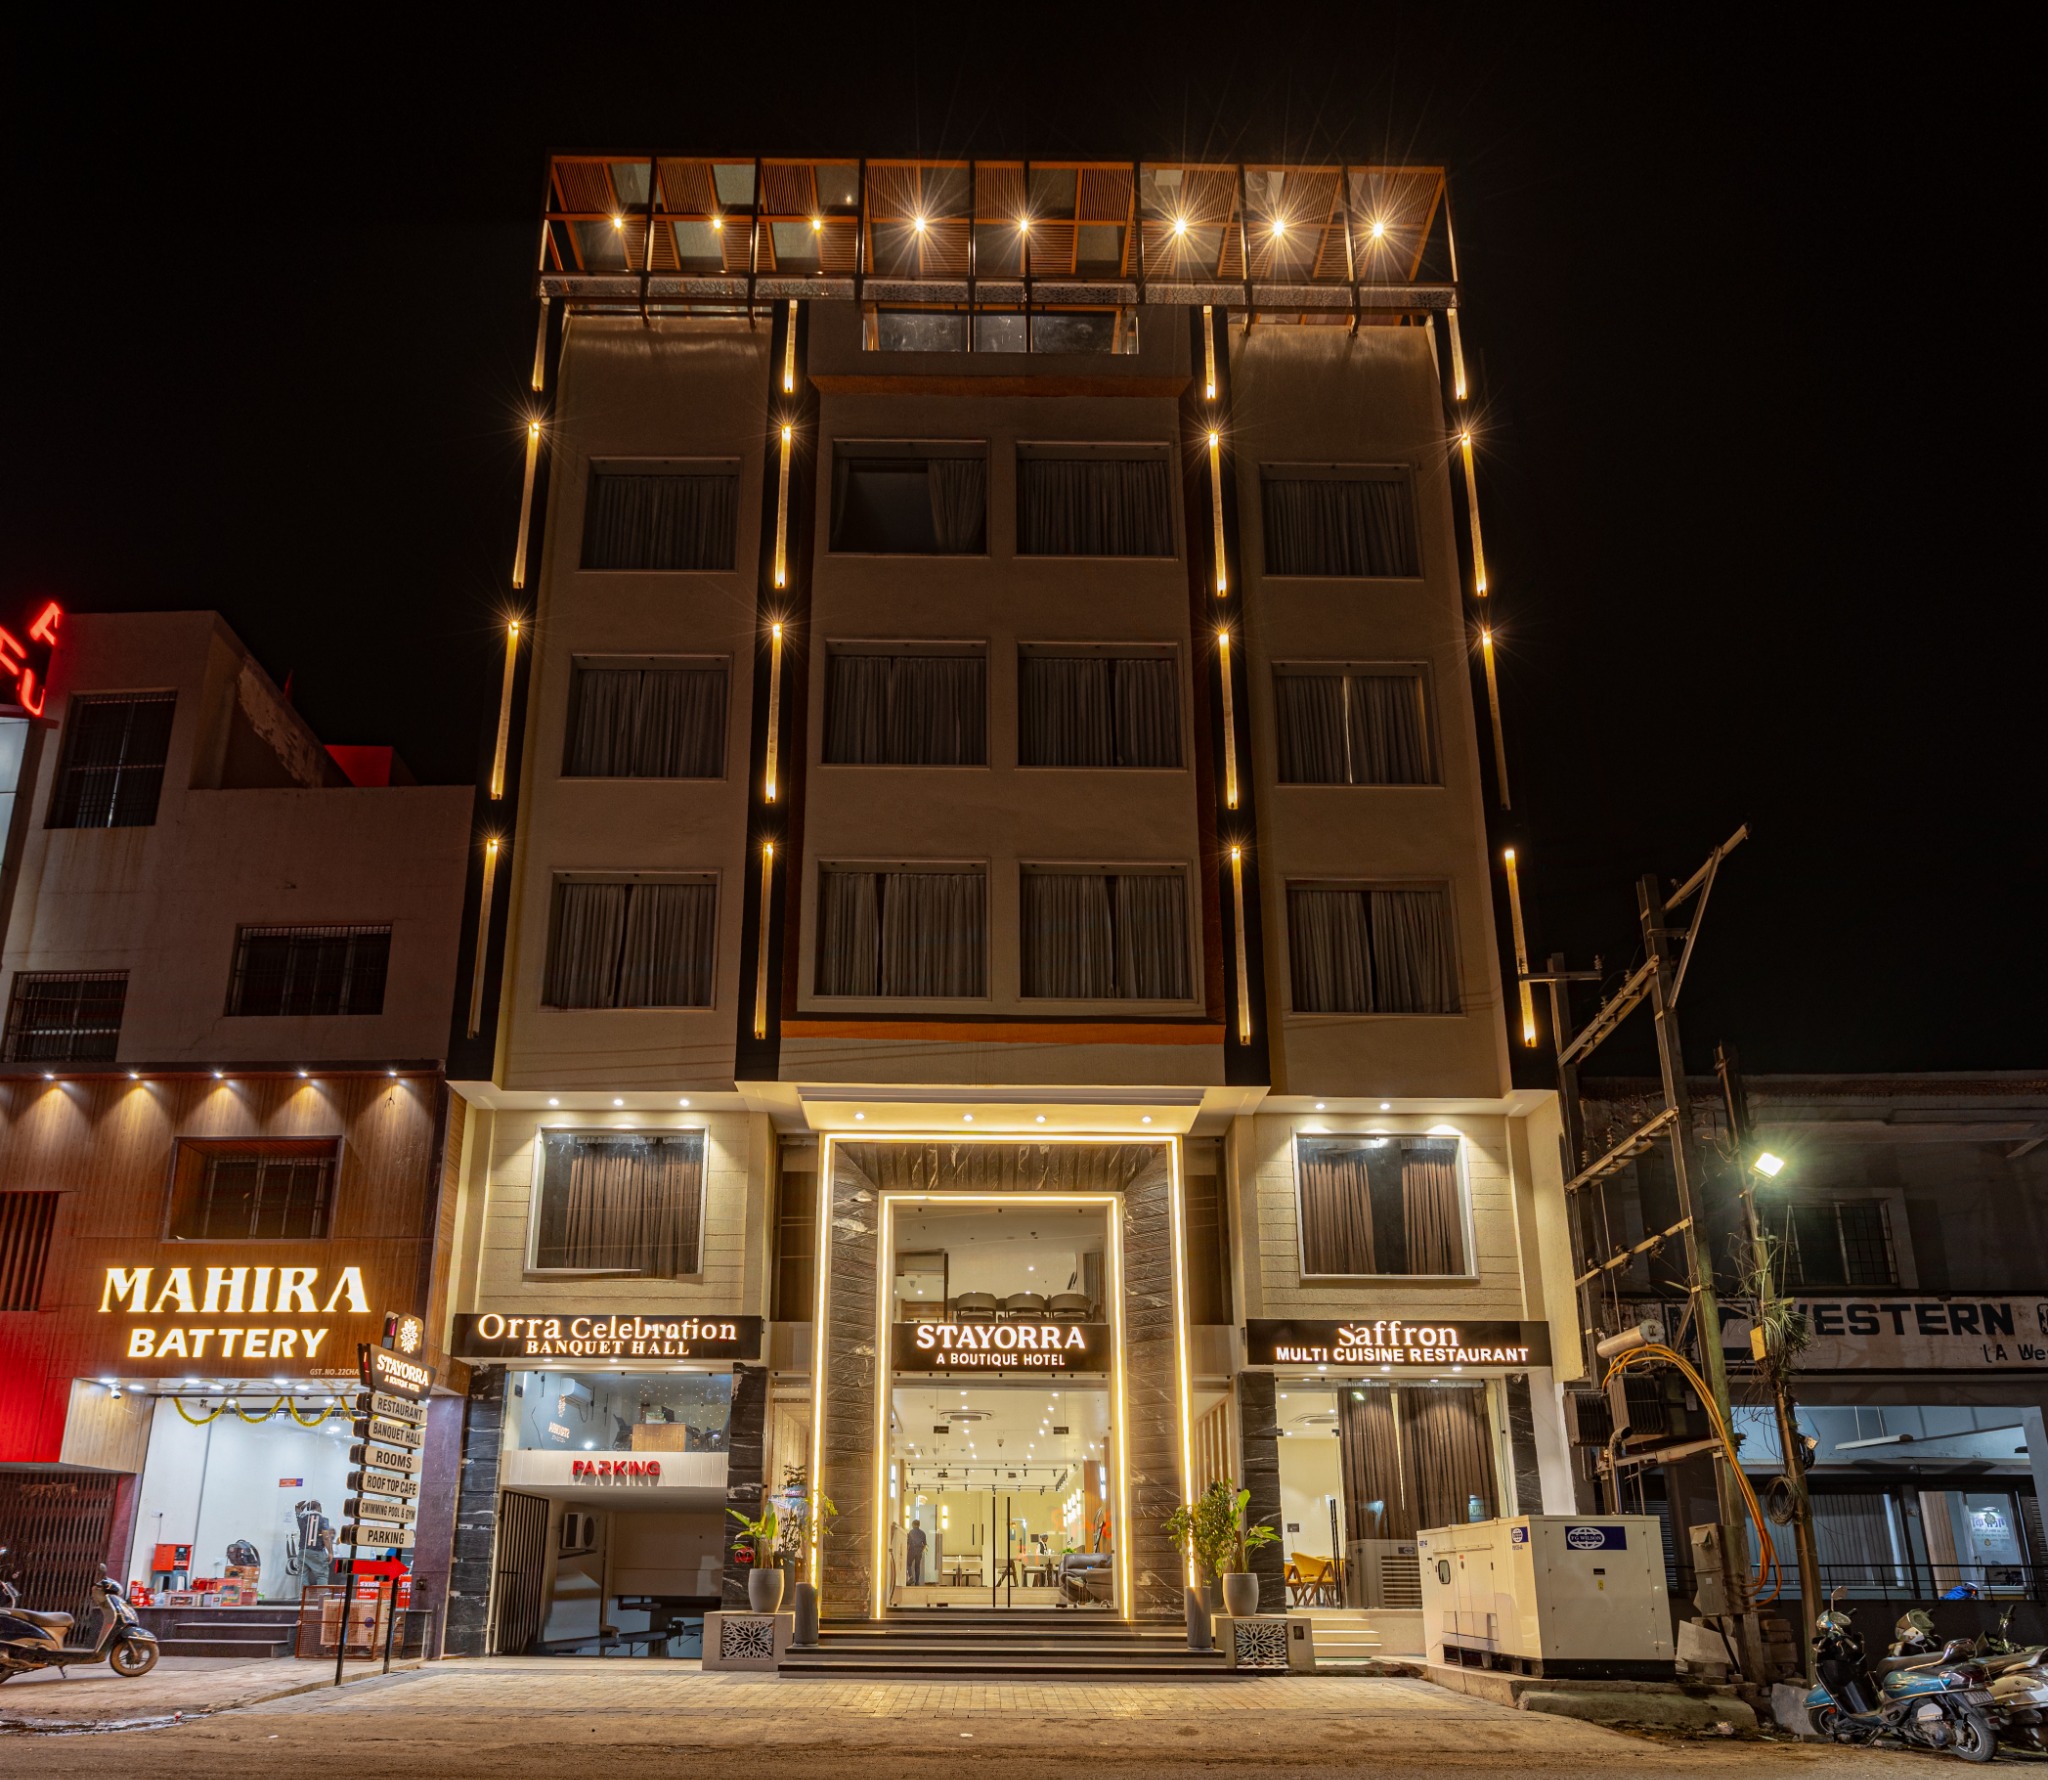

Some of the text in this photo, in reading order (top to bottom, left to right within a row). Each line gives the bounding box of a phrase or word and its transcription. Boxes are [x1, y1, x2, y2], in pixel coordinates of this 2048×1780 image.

[97, 1266, 372, 1313] MAHIRA
[477, 1313, 737, 1341] Orra Celebration
[1797, 1303, 2015, 1336] ESTERN
[127, 1328, 330, 1358] BATTERY
[916, 1324, 1086, 1350] STAYORRA
[1337, 1320, 1460, 1347] Saffron
[525, 1339, 690, 1356] BANQUET HALL
[1276, 1347, 1529, 1362] MULTI CUISINE RESTAURANT
[376, 1354, 429, 1387] STAYORRA
[936, 1353, 1066, 1367] A BOUTIQUE HOTEL
[377, 1398, 423, 1421] RESTAURANT
[373, 1422, 421, 1446] BANQUET HALL
[376, 1450, 412, 1469] ROOMS
[572, 1460, 661, 1476] PARKING
[367, 1475, 417, 1495] ROOF TOP CAFE
[361, 1502, 388, 1516] SWIMMING
[387, 1506, 400, 1518] POOL
[401, 1508, 405, 1518] &
[367, 1529, 405, 1544] PARKING
